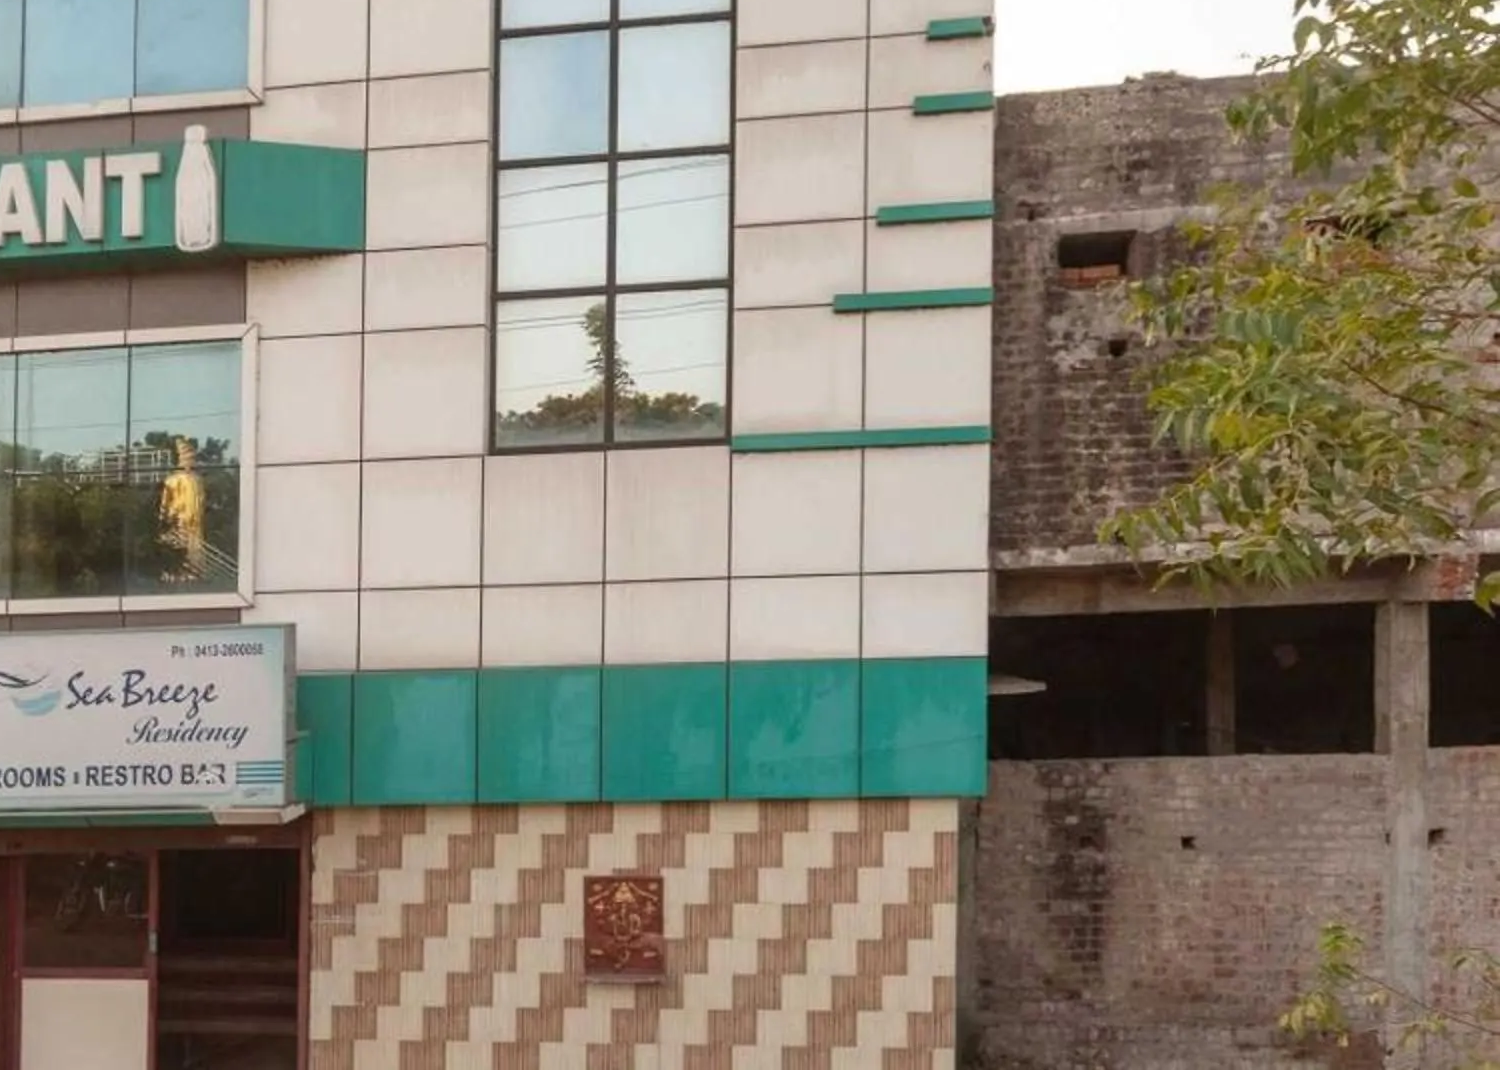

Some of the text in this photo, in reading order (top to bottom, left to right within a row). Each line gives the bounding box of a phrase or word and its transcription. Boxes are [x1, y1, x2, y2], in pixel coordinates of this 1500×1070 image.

[66, 669, 219, 720] Sea Breeze
[126, 716, 249, 748] Residency
[85, 764, 173, 787] RESTRO
